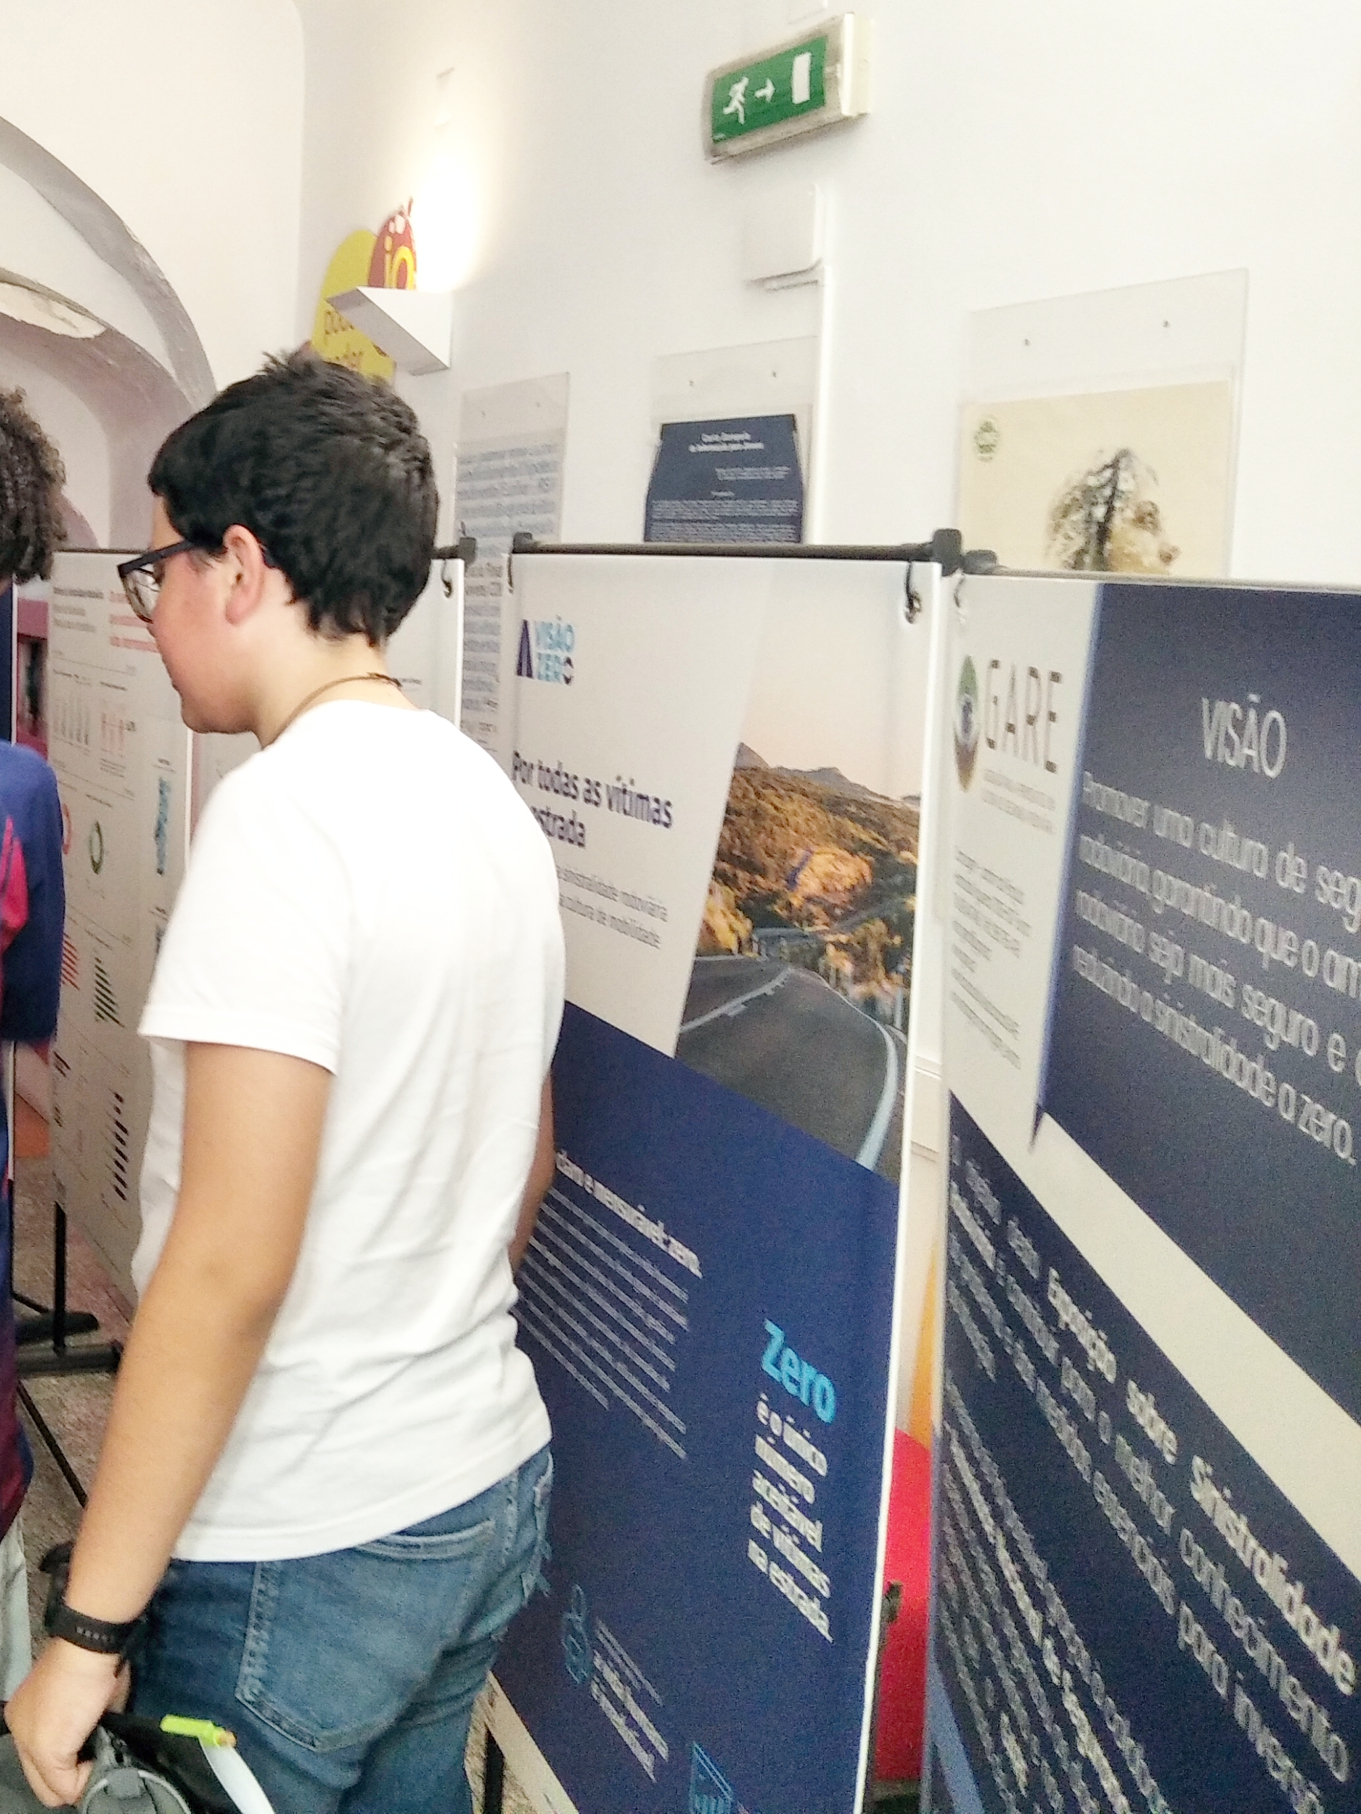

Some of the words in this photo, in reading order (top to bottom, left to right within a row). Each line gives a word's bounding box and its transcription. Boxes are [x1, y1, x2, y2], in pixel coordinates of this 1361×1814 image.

[984, 658, 1063, 774] GARE
[1201, 693, 1288, 779] VISÃO
[512, 749, 534, 787] Por
[537, 758, 580, 802] todas
[583, 776, 602, 808] as
[605, 774, 673, 829] vítimas
[1152, 804, 1195, 849] uma
[1198, 818, 1270, 880] cultura
[1275, 840, 1309, 895] de
[1253, 916, 1300, 970] que
[1301, 939, 1321, 978] o
[1188, 952, 1238, 1010] mais
[1241, 983, 1319, 1057] seguro
[1327, 1032, 1347, 1073] e
[1277, 1082, 1296, 1122] a
[1297, 1093, 1357, 1166] zero.
[760, 1317, 836, 1425] Zero
[770, 1411, 783, 1437] o
[750, 1500, 772, 1540] de
[1126, 1380, 1179, 1465] sobre
[1191, 1455, 1358, 1697] Sinistralidade
[1180, 1528, 1349, 1782] conhecimento
